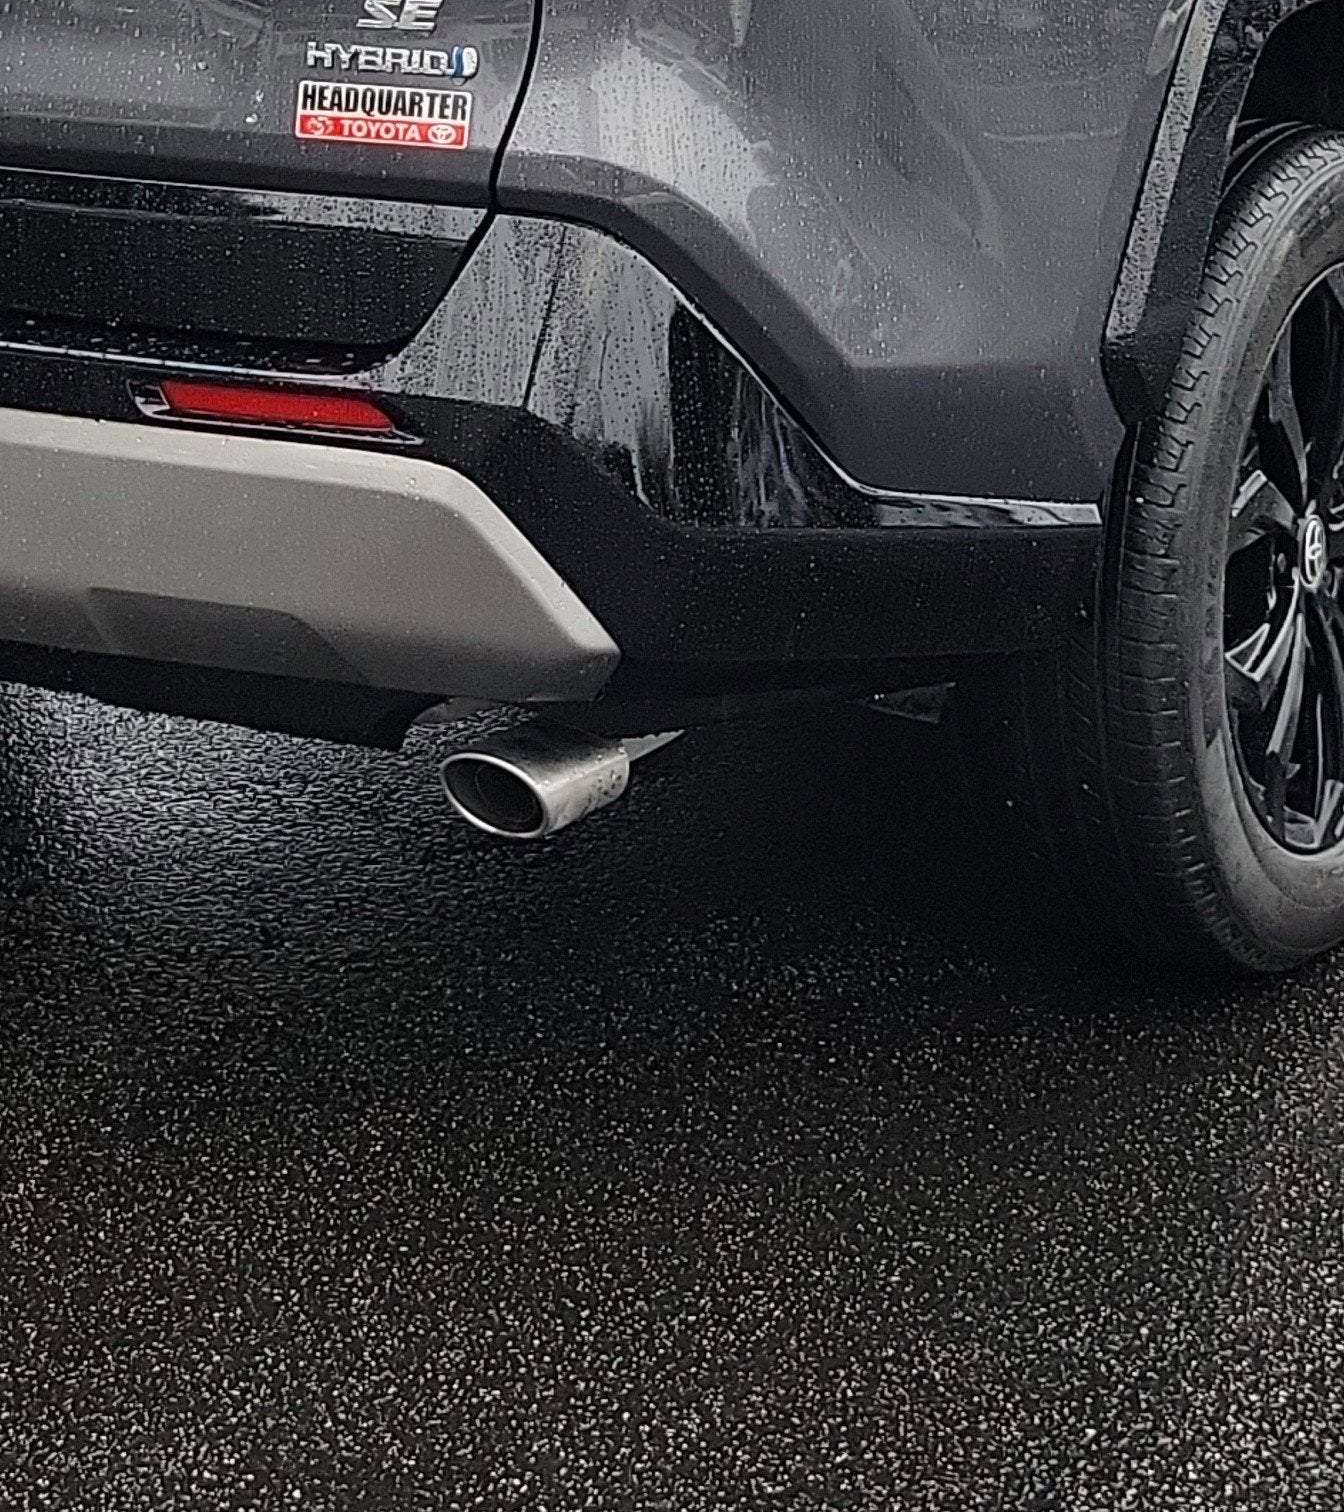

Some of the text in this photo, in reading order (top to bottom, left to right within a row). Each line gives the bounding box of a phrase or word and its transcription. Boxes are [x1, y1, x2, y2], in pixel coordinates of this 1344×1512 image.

[306, 41, 453, 76] HYBRID
[301, 83, 468, 121] HEADQUARTER
[339, 119, 422, 142] TOYOTA
